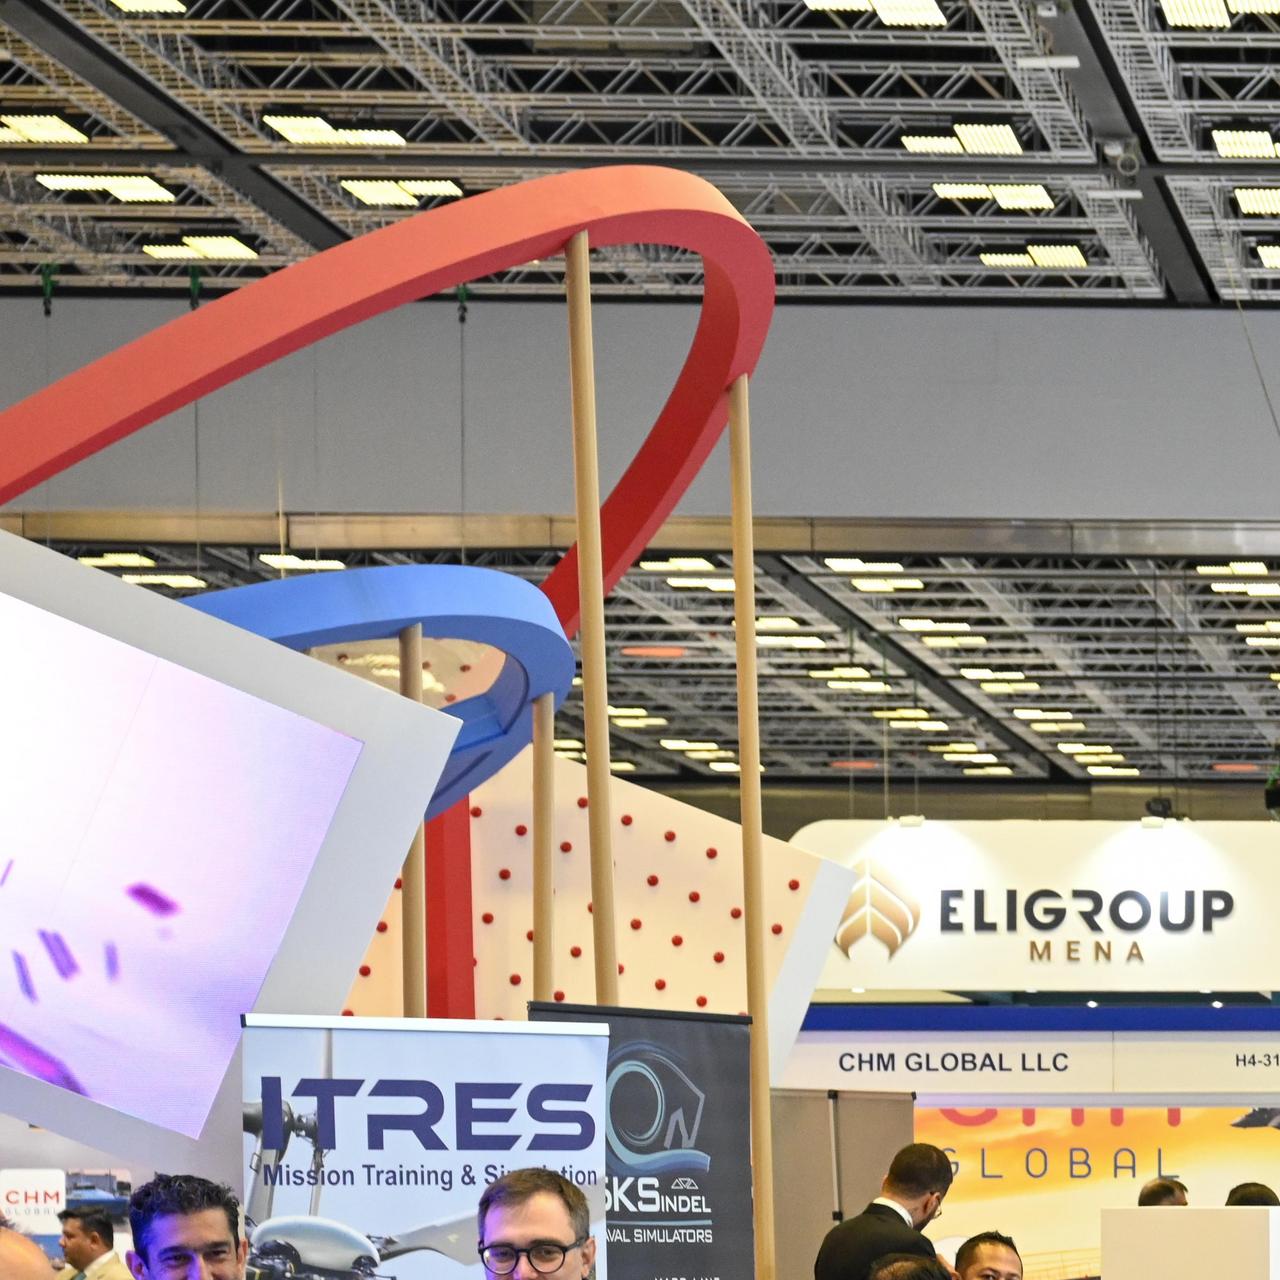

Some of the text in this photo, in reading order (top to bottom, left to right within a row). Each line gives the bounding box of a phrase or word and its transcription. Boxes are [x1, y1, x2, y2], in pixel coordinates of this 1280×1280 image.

[940, 889, 1235, 933] ELIGROUP
[1029, 940, 1146, 962] MENA
[838, 1052, 1070, 1073] CHM GLOBAL LLC
[261, 1076, 597, 1152] ITRES
[263, 1164, 598, 1191] Mission Training & Sition
[5, 1189, 60, 1204] CHM
[633, 1228, 713, 1243] SIMULATORS
